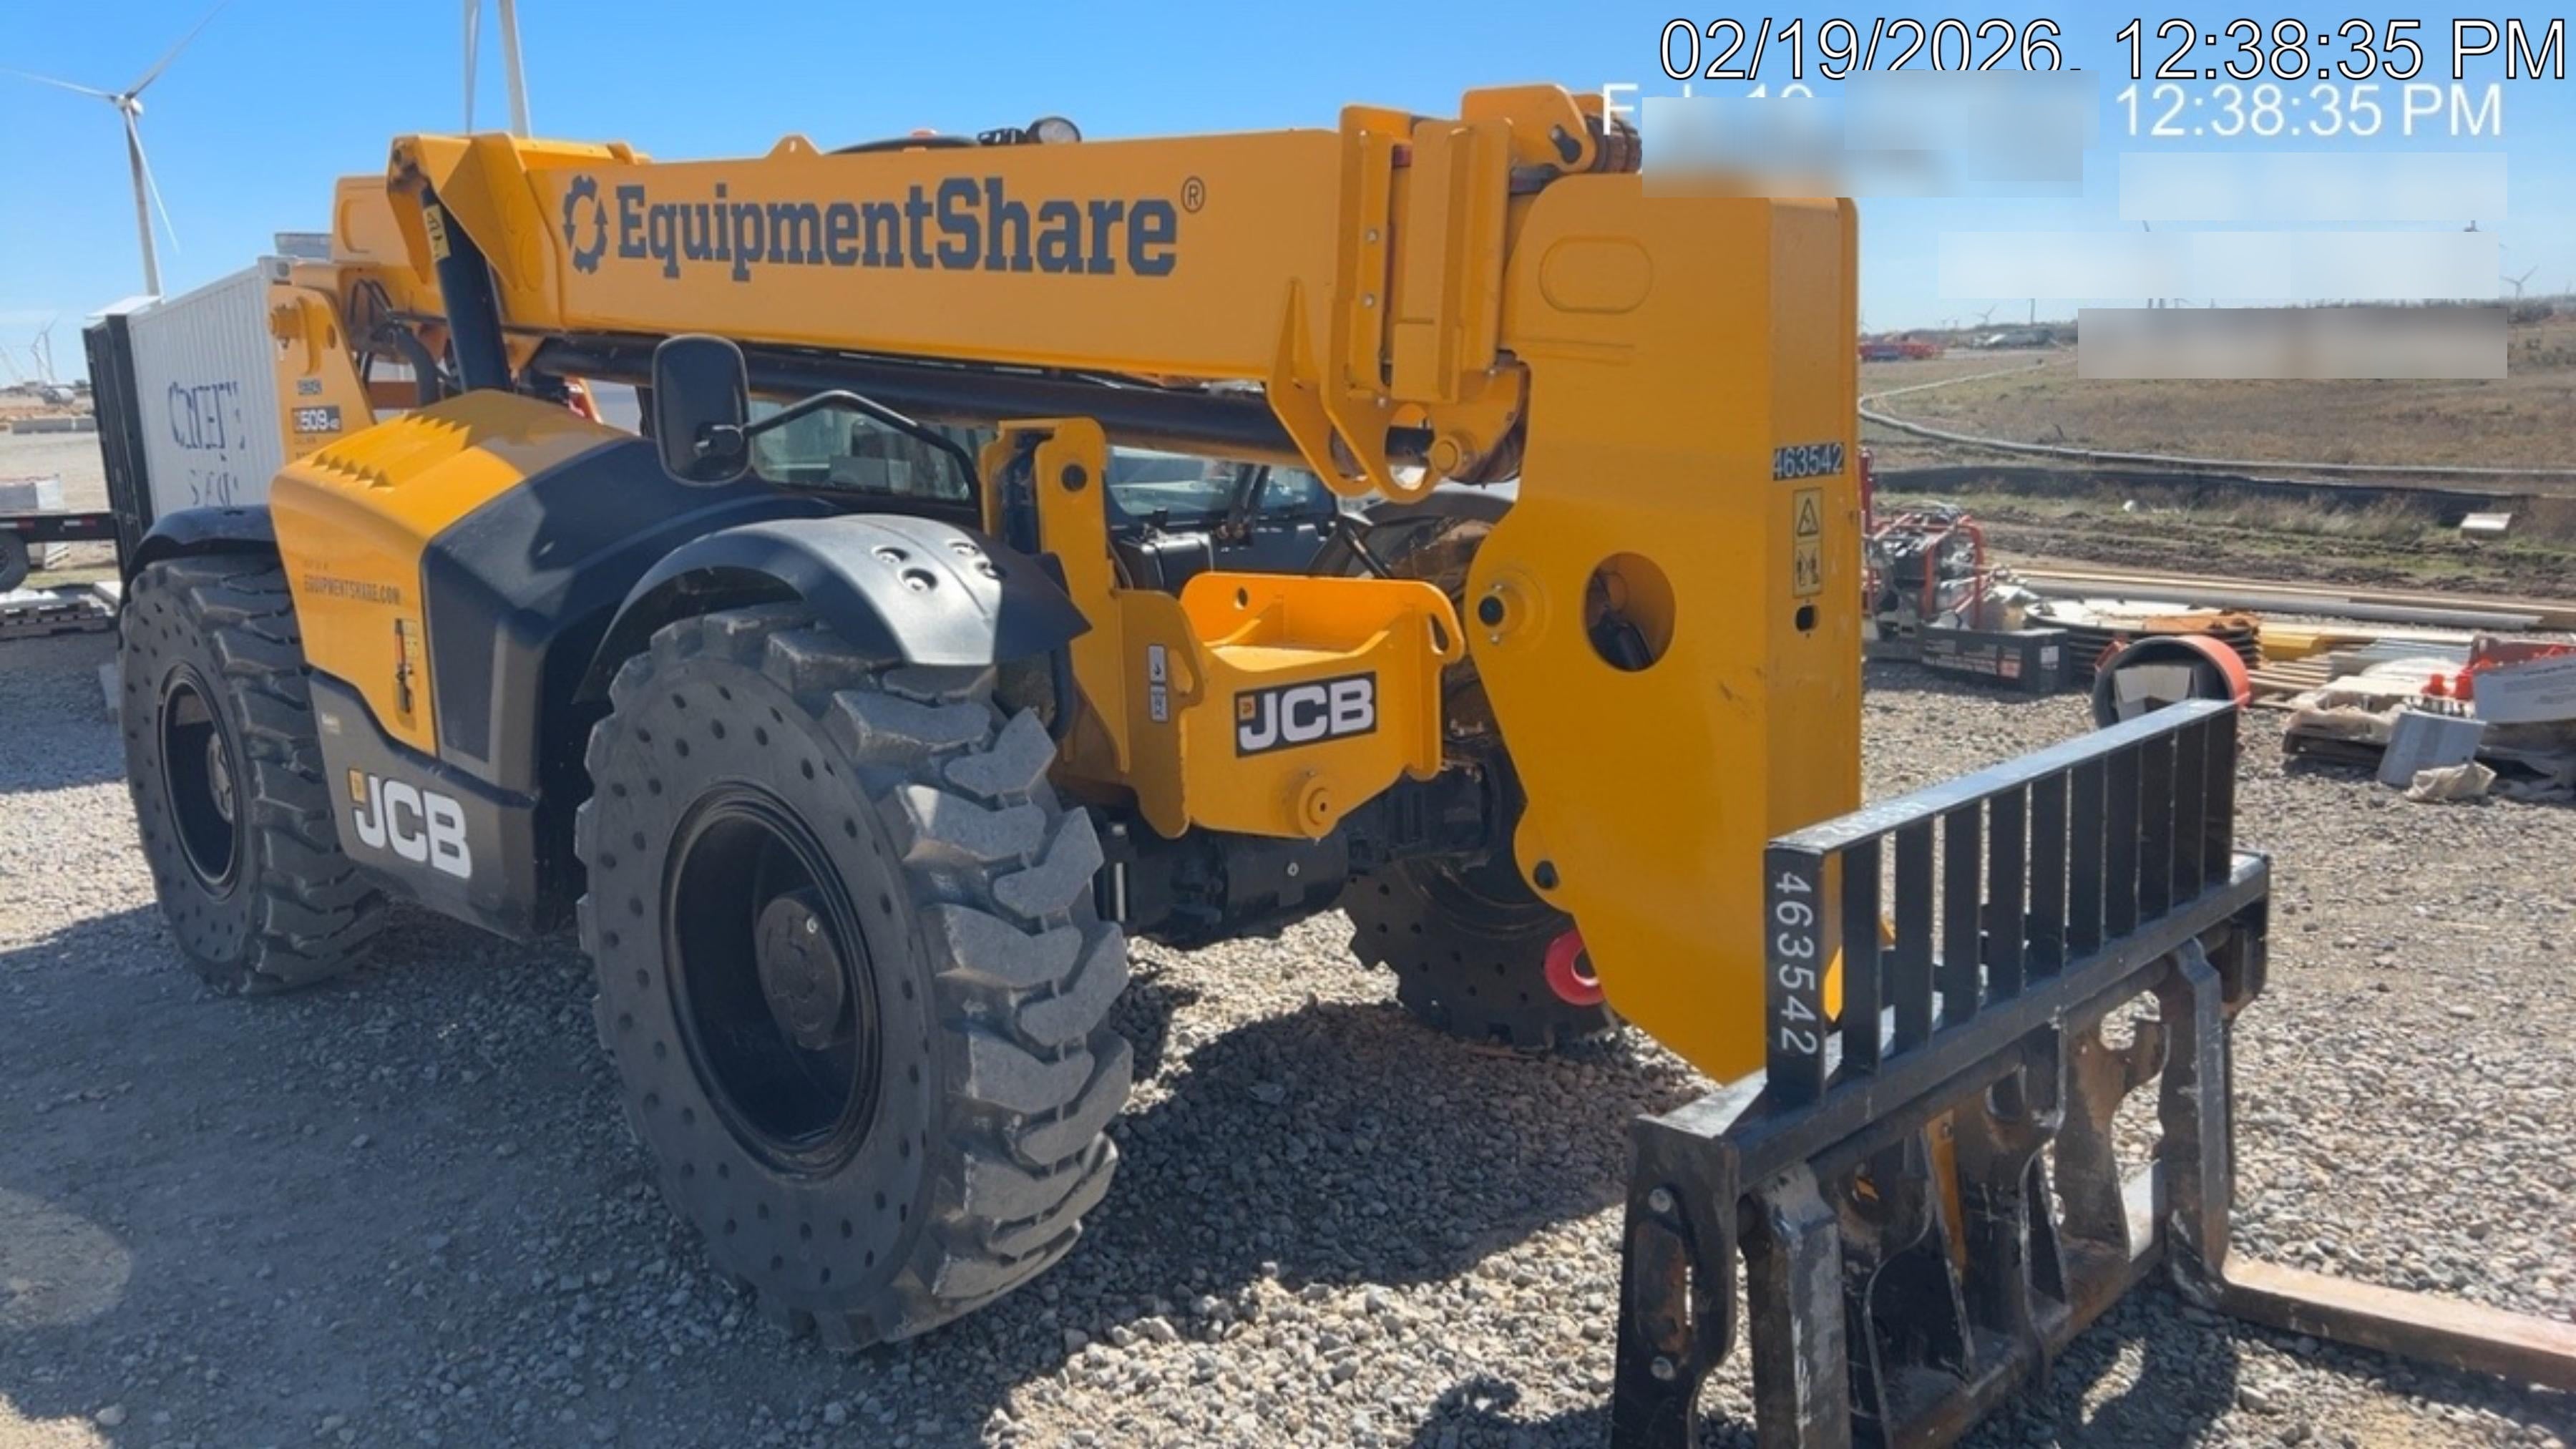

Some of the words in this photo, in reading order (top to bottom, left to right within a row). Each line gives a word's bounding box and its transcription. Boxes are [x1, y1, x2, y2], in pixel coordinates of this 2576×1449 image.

[1772, 442, 1845, 479] 463542
[1239, 678, 1374, 751] JCB
[355, 773, 472, 879] JCB
[1775, 872, 1818, 1055] 463542
